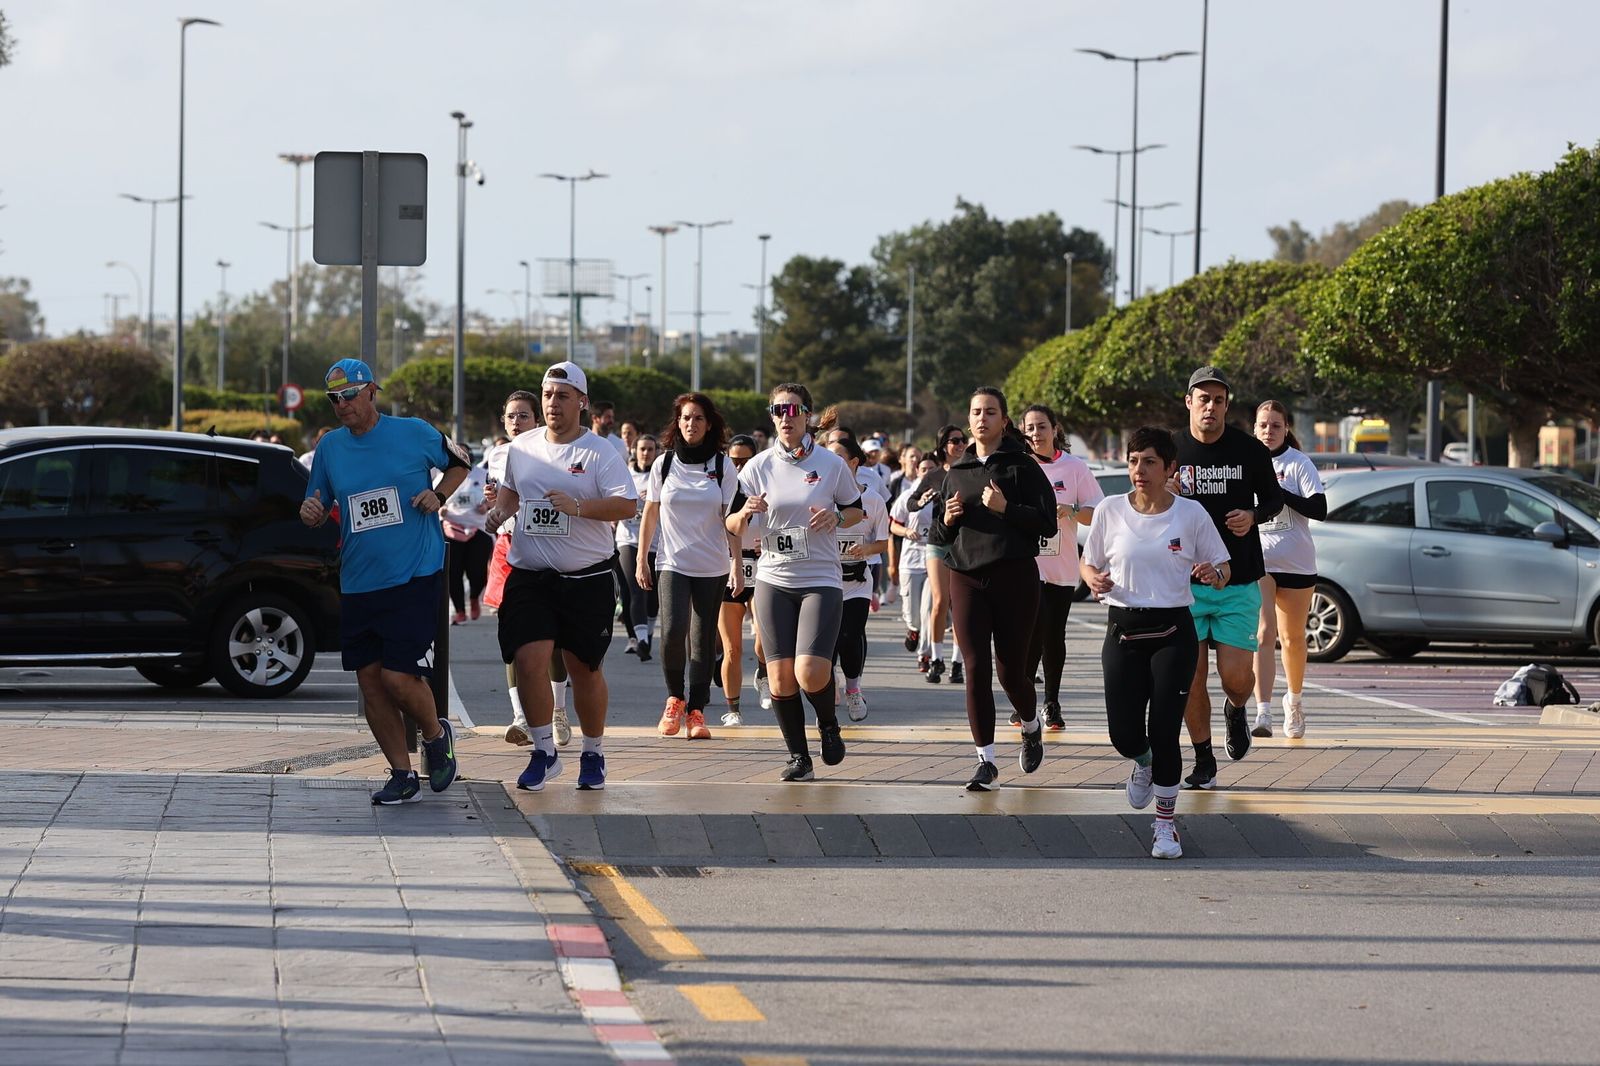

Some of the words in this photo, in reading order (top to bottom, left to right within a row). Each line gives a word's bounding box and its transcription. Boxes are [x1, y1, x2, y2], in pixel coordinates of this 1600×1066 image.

[1195, 465, 1242, 480] Basketball
[1196, 480, 1227, 494] School
[360, 497, 389, 518] 388
[532, 508, 560, 525] 392
[777, 535, 793, 551] 64
